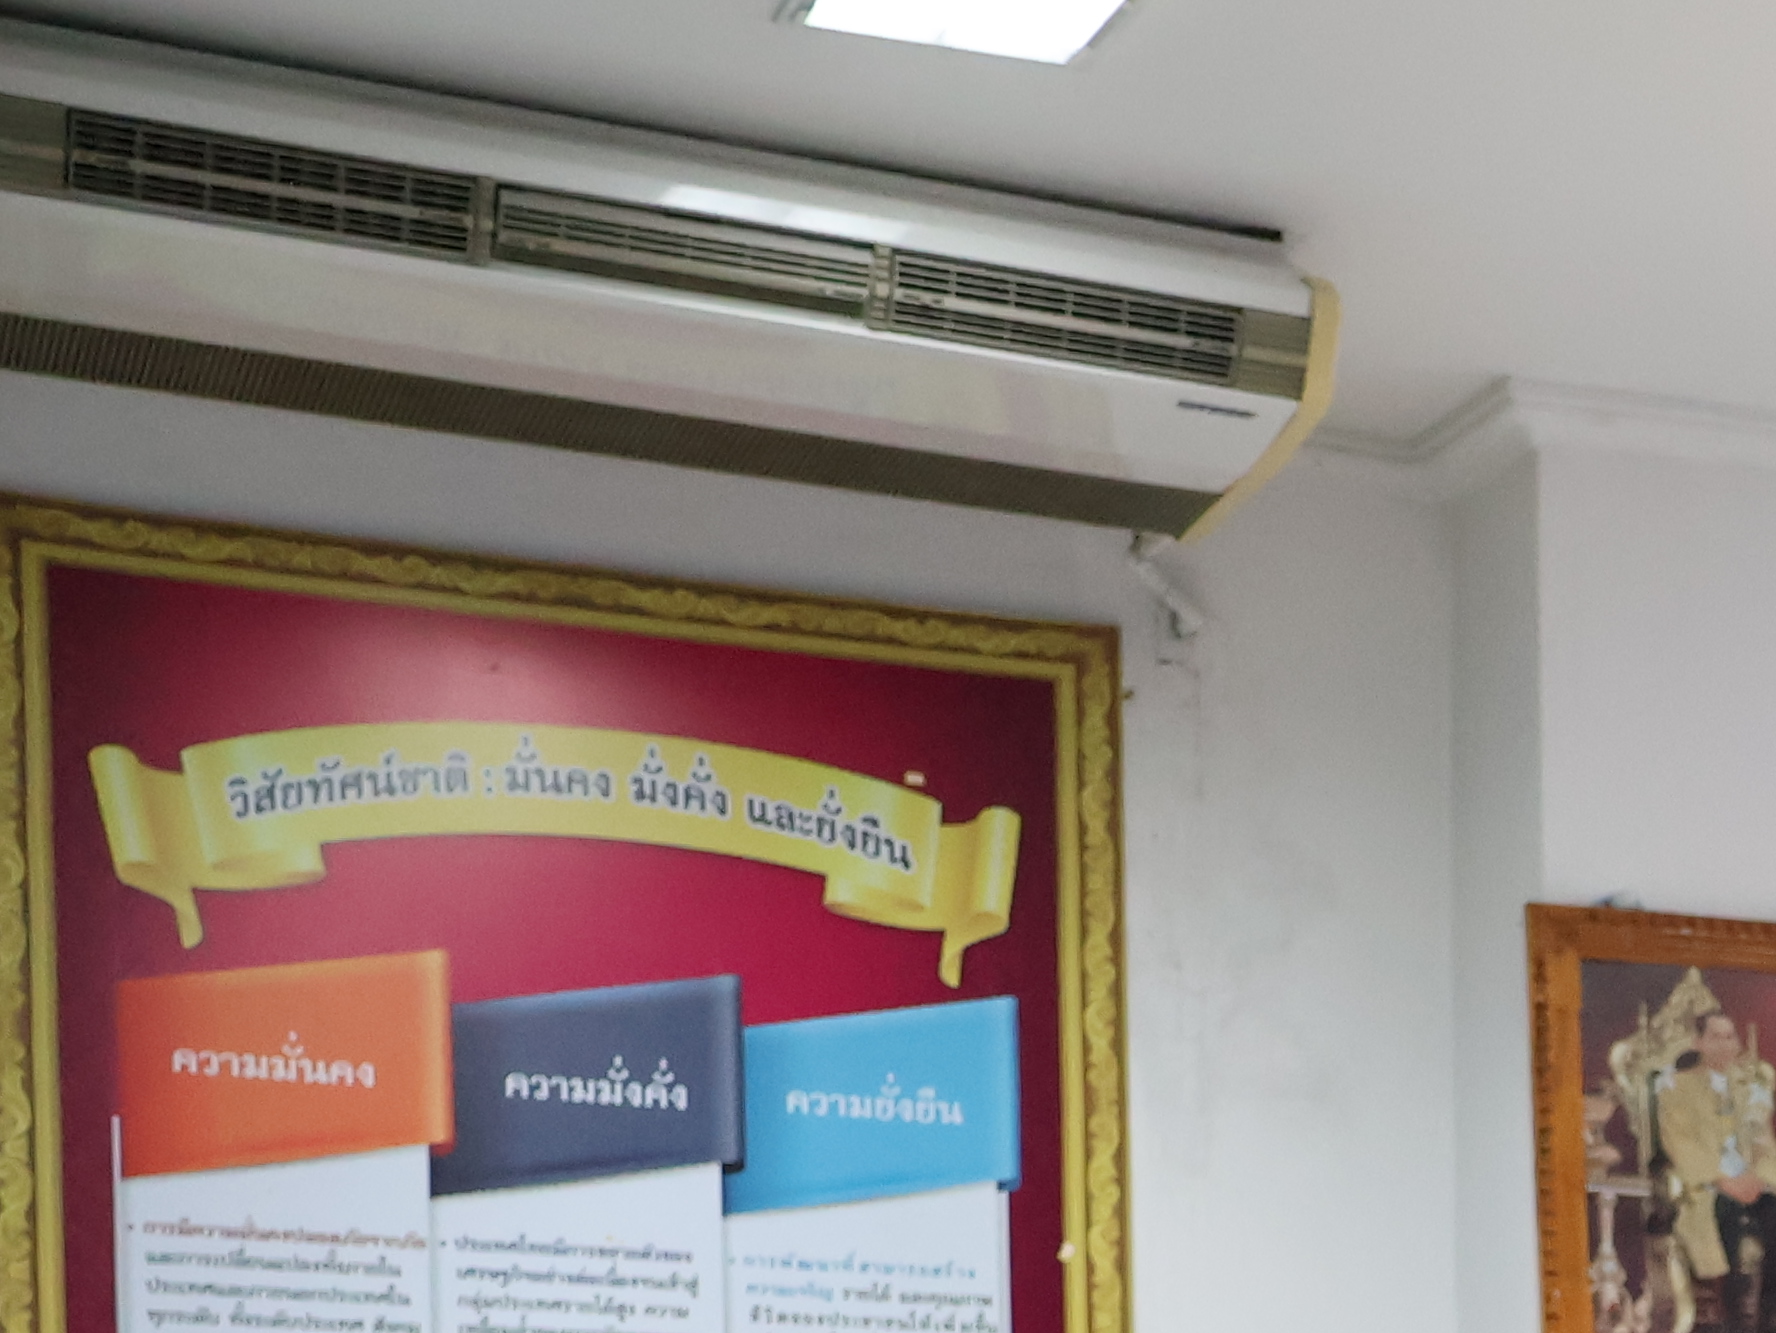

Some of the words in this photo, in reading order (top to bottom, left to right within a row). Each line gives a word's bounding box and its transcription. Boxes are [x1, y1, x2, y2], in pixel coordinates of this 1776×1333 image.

[172, 1030, 378, 1091] ความมั่นคง
[503, 1055, 689, 1113] ความมั่งคั่ง
[784, 1081, 965, 1127] ความยั่งยืน
